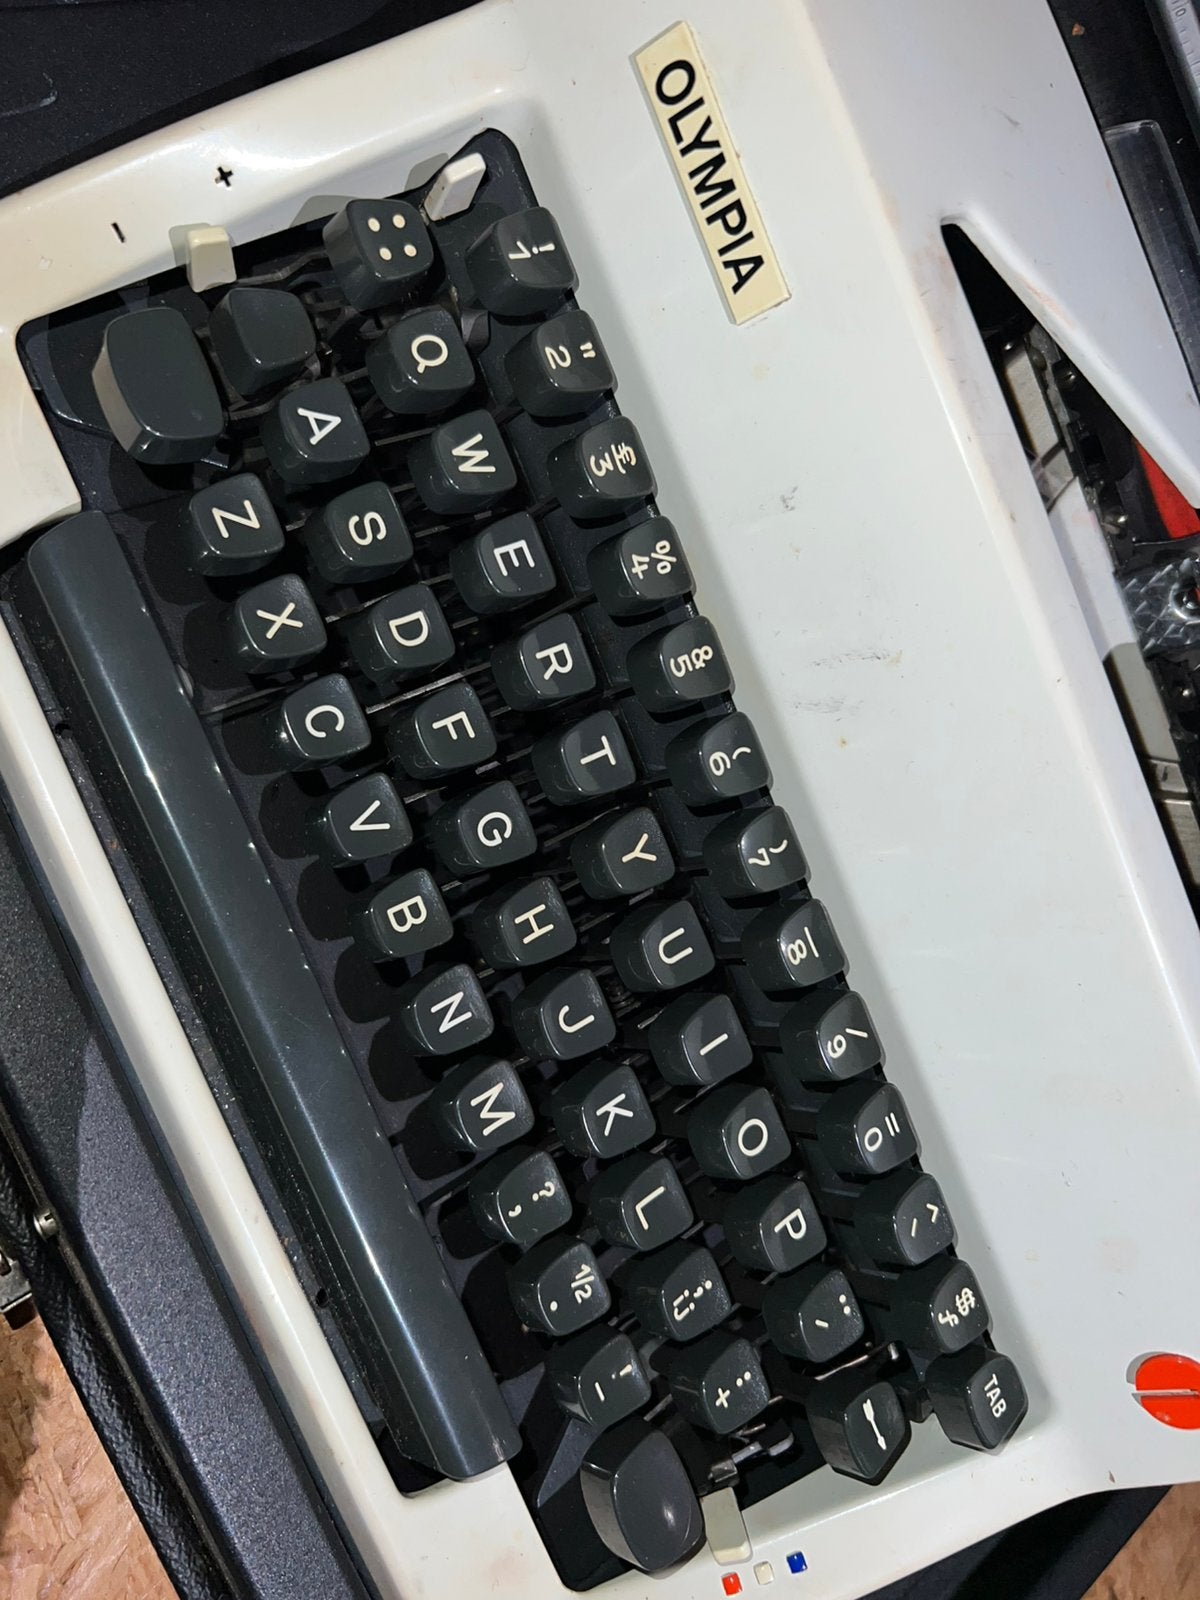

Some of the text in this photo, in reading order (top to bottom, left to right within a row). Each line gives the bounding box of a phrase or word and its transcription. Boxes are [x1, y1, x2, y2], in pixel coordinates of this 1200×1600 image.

[654, 58, 765, 295] OLYMPIA
[508, 240, 532, 260] 1
[411, 334, 449, 374] Q
[544, 345, 572, 370] 2
[297, 407, 342, 446] A
[451, 433, 496, 473] W
[589, 453, 614, 477] 3
[211, 499, 261, 539] Z
[348, 511, 387, 546] S
[493, 539, 535, 577] E
[631, 553, 650, 580] 4
[650, 539, 677, 575] %
[256, 602, 304, 640] X
[388, 610, 429, 647] D
[535, 642, 573, 681] R
[669, 653, 694, 678] 5
[689, 645, 714, 672] &
[304, 704, 345, 738] C
[431, 710, 476, 740] F
[579, 735, 617, 766] T
[708, 751, 732, 777] 6
[349, 799, 391, 831] V
[477, 811, 513, 847] G
[621, 833, 657, 863] Y
[747, 847, 773, 867] 7
[386, 895, 428, 933] B
[514, 903, 554, 945] H
[658, 927, 694, 965] U
[786, 938, 808, 966] 8
[430, 991, 473, 1034] N
[558, 1005, 595, 1033] J
[826, 1034, 847, 1059] 9
[470, 1082, 516, 1136] M
[595, 1093, 634, 1137] K
[737, 1118, 769, 1157] O
[863, 1126, 883, 1153] 0
[532, 1178, 558, 1202] ?
[635, 1185, 666, 1230] L
[773, 1208, 807, 1240] P
[954, 1286, 976, 1318] $
[983, 1373, 1007, 1418] TAB
